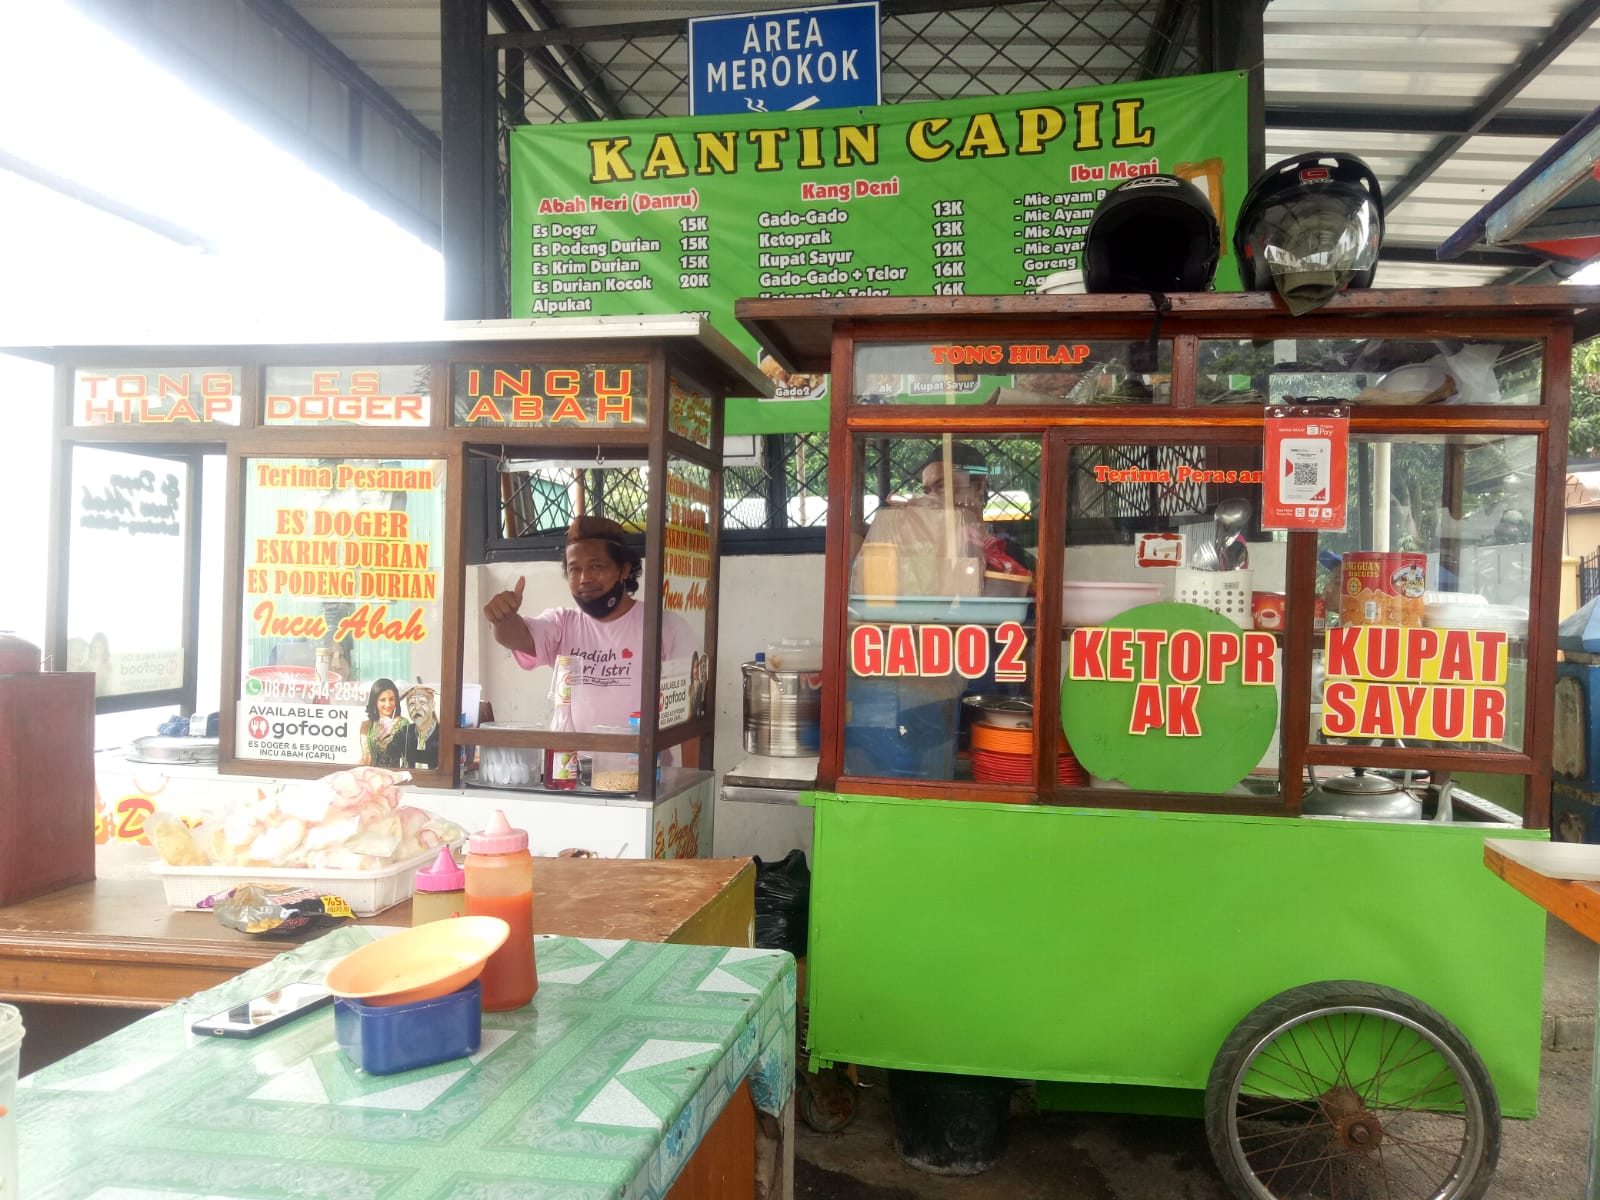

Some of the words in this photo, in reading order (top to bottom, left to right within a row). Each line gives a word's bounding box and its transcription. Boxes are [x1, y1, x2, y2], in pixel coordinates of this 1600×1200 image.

[743, 17, 823, 55] AREA
[707, 49, 859, 93] MEROKOK
[589, 124, 880, 183] KANTIN
[907, 97, 1154, 162] CAPIL
[1070, 163, 1104, 184] Ibu
[1109, 156, 1160, 180] Meni
[538, 197, 586, 215] Abah
[590, 193, 628, 212] Heri
[632, 188, 699, 215] (Danru)
[801, 182, 851, 203] Kang
[855, 176, 900, 198] Deni
[1023, 193, 1051, 208] Mie
[1053, 190, 1094, 207] ayam
[758, 208, 849, 228] Gado-Gado
[932, 199, 965, 217] 13K
[1023, 209, 1051, 223] Mie
[1053, 207, 1095, 223] Ayam
[532, 224, 548, 238] Es
[551, 222, 597, 239] Doger
[679, 216, 709, 233] 15K
[758, 229, 832, 249] Ketoprak
[932, 220, 965, 238] 13K
[1023, 225, 1051, 239] Mie
[532, 243, 548, 257] Es
[551, 240, 608, 257] Podeng
[611, 236, 661, 254] Durian
[680, 236, 709, 251] 15K
[758, 251, 806, 269] Kupat
[809, 249, 853, 268] Sayur
[932, 241, 965, 258] 12K
[1023, 241, 1051, 256] Mie
[532, 261, 549, 276] Es
[552, 258, 587, 275] Krim
[590, 257, 640, 274] Durian
[680, 254, 710, 270] 15K
[758, 269, 849, 288] Gado-Gado
[865, 266, 907, 283] Telor
[932, 261, 965, 279] 16K
[1023, 256, 1078, 272] Goreng
[532, 280, 549, 295] Es
[552, 277, 602, 294] Durian
[605, 275, 653, 292] Kocok
[679, 273, 711, 289] 20K
[932, 282, 965, 296] 16K
[532, 297, 592, 314] Alpukat
[931, 345, 1004, 365] TONG
[1008, 344, 1091, 365] HILAP
[80, 371, 234, 399] TONG
[311, 369, 381, 397] ES
[468, 369, 632, 397] INCU
[775, 386, 810, 398] Gado2
[912, 380, 944, 393] Kupat
[945, 379, 976, 393] Sayur
[84, 395, 235, 424] HILAP
[266, 395, 426, 422] DOGER
[465, 395, 633, 424] ABAH
[1319, 428, 1333, 437] Pay
[256, 463, 332, 490] Terima
[338, 464, 434, 492] Pesanan
[1094, 465, 1170, 484] Terima
[275, 508, 306, 535] ES
[312, 508, 410, 540] DOGER
[255, 538, 339, 569] ESKRIM
[343, 540, 429, 572] DURIAN
[246, 568, 269, 595] ES
[273, 569, 355, 598] PODENG
[360, 572, 437, 600] DURIAN
[253, 600, 328, 640] Incu
[333, 603, 427, 643] Abah
[570, 647, 617, 663] Hadiah
[1069, 626, 1278, 686] KETOPR
[1326, 626, 1508, 684] KUPAT
[601, 662, 632, 676] Istri
[249, 705, 324, 719] AVAILABLE
[328, 709, 348, 720] ON
[665, 689, 686, 709] gofood
[1128, 683, 1202, 737] AK
[1323, 681, 1506, 741] SAYUR
[272, 720, 348, 740] gofood
[248, 740, 259, 748] ES
[261, 741, 290, 750] DOGER
[291, 743, 298, 751] &
[300, 743, 310, 751] ES
[312, 744, 347, 753] PODENG
[259, 749, 279, 757] INCU
[281, 750, 304, 758] ABAH
[305, 751, 335, 761] (CAPIL)
